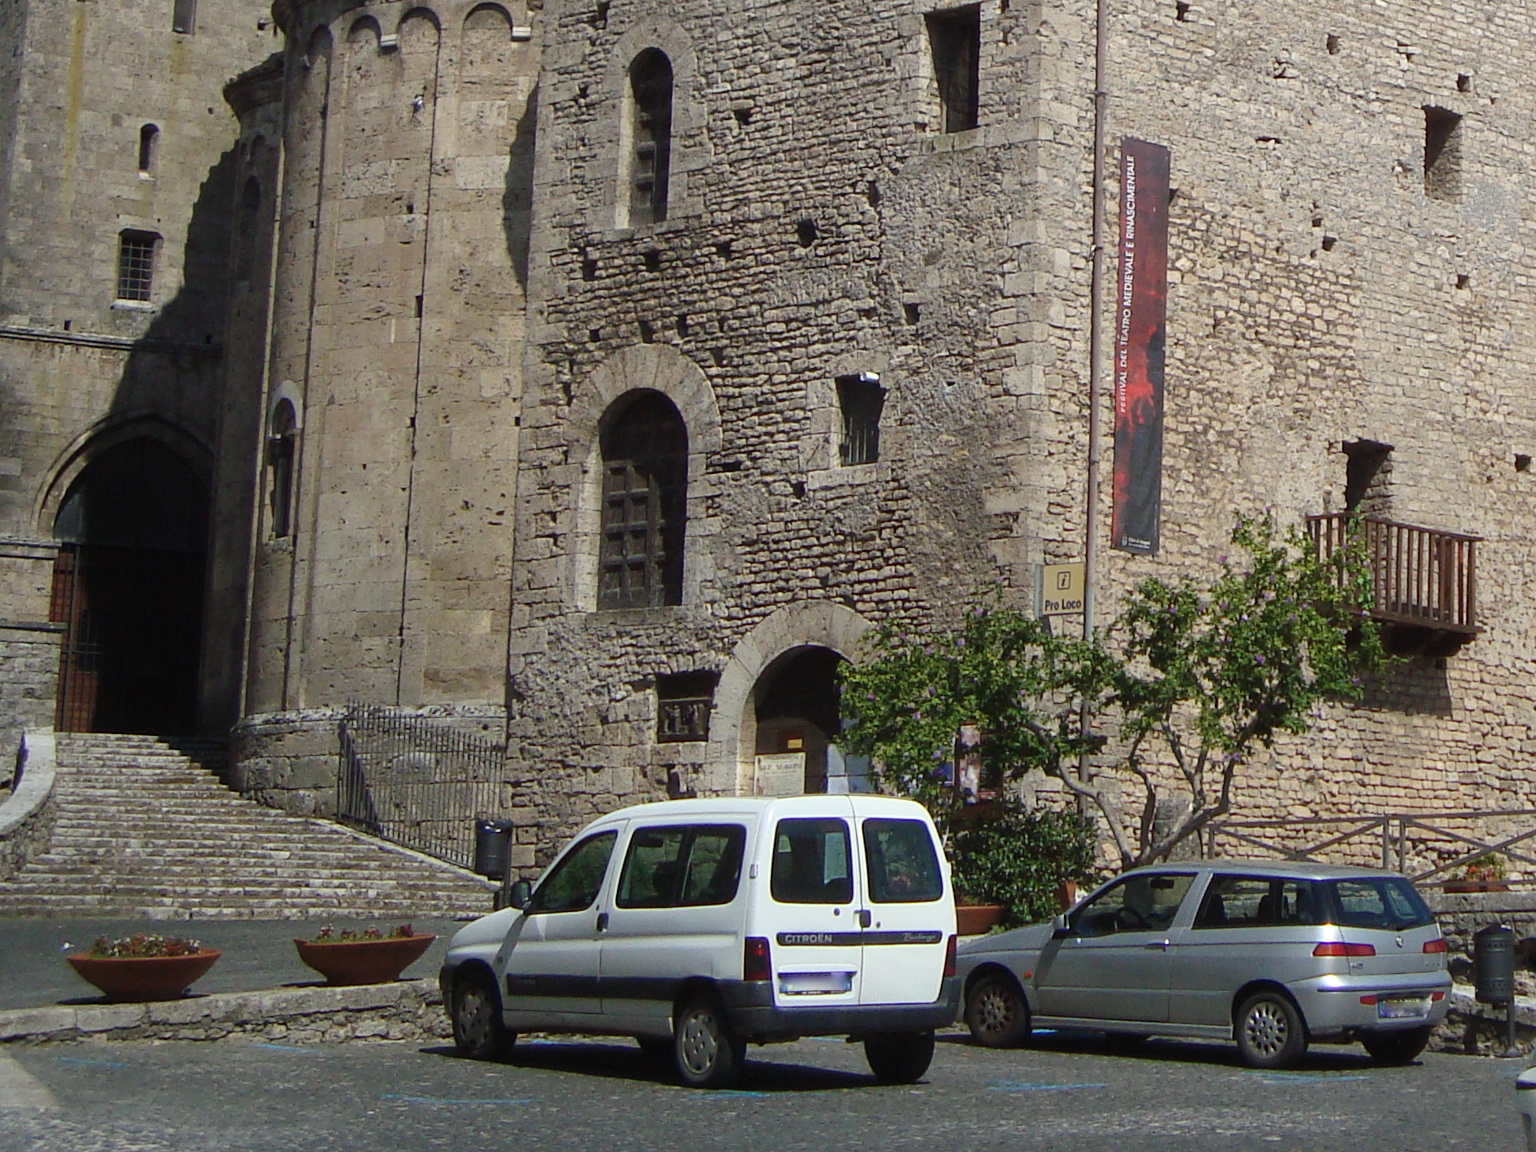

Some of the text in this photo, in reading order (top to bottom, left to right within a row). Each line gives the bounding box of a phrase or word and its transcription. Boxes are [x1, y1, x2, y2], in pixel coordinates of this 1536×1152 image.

[1126, 155, 1136, 239] RINASCIMENTALE
[1123, 250, 1134, 306] MEDIEVALE
[1120, 308, 1132, 345] TEATRO
[1120, 349, 1128, 368] DEL
[1045, 598, 1082, 611] Pro Loco
